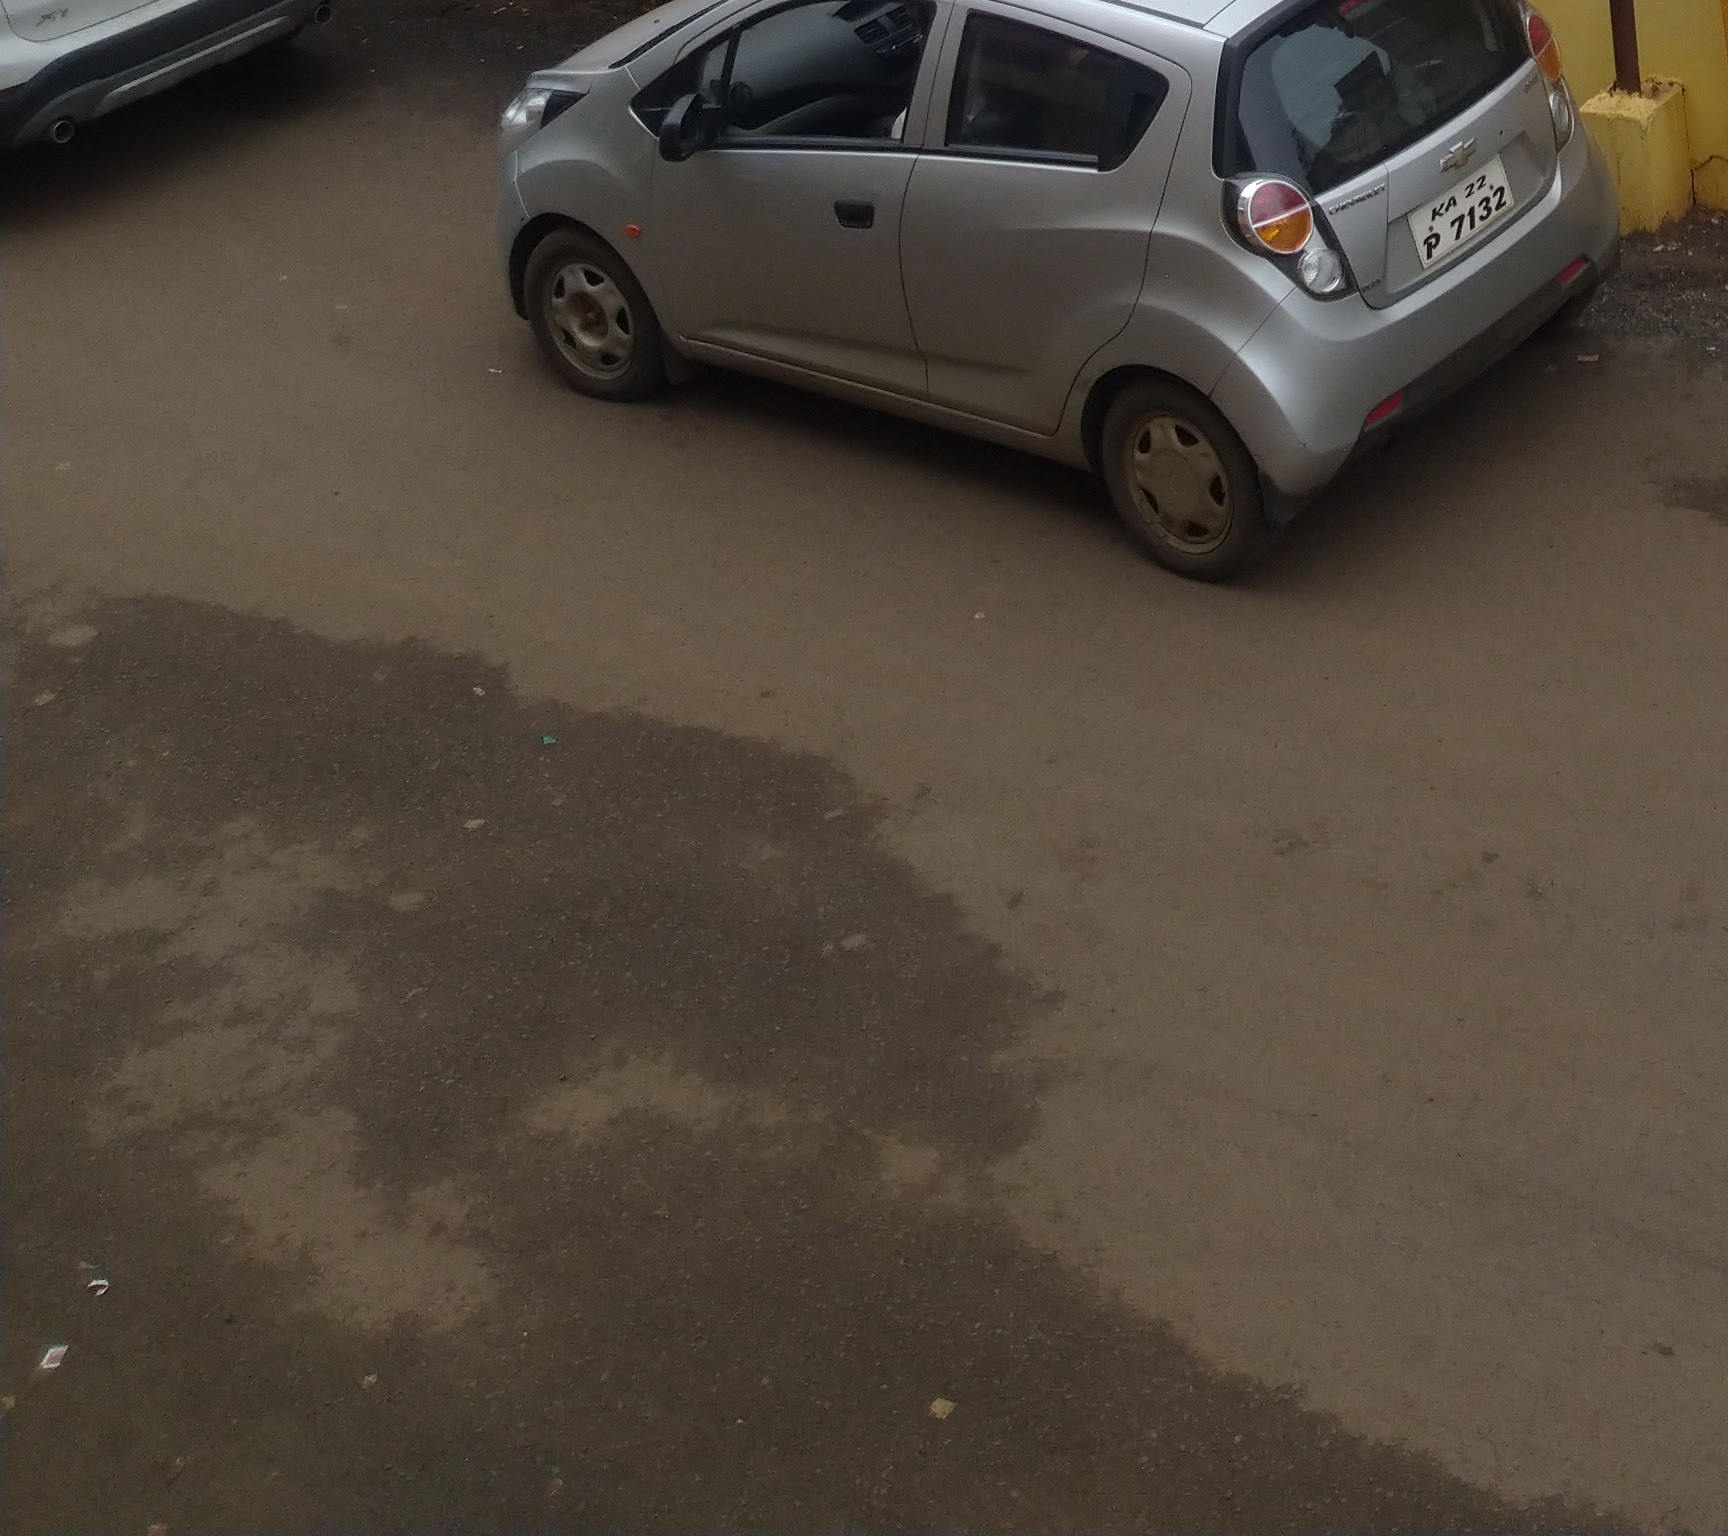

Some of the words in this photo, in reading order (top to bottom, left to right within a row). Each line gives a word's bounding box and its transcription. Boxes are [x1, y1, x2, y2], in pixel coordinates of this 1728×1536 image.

[1422, 233, 1441, 261] P
[1450, 185, 1508, 242] 7132
[1430, 193, 1458, 222] KA
[1464, 173, 1488, 199] 22
